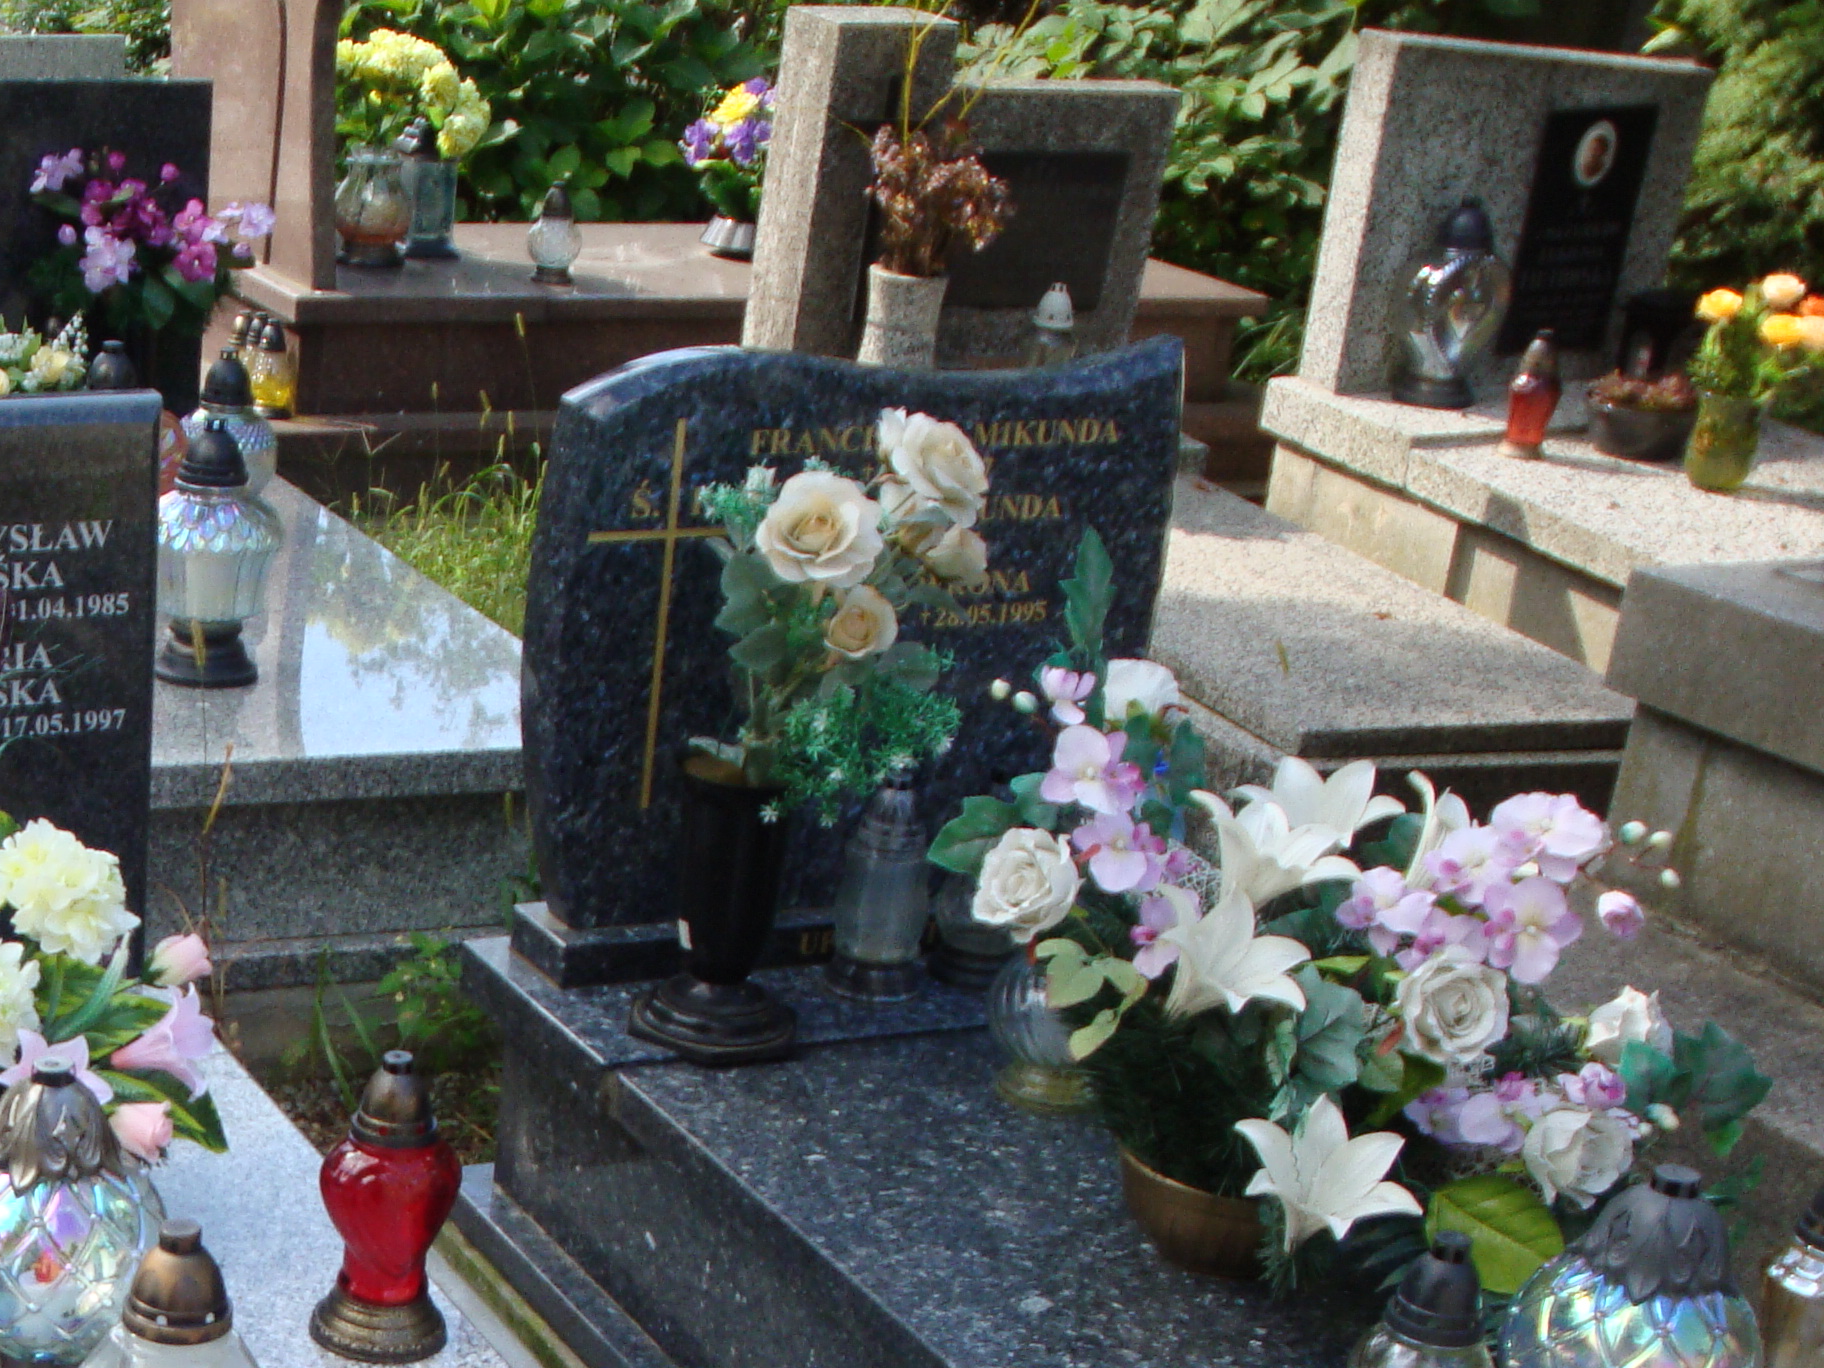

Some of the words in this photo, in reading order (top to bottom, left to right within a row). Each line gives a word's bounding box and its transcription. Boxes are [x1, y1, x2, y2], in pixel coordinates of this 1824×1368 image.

[974, 418, 1120, 448] MIKUNDA
[976, 494, 1063, 522] UNDA
[6, 592, 130, 624] 1.04.1985
[1, 707, 127, 739] 17.05.1997
